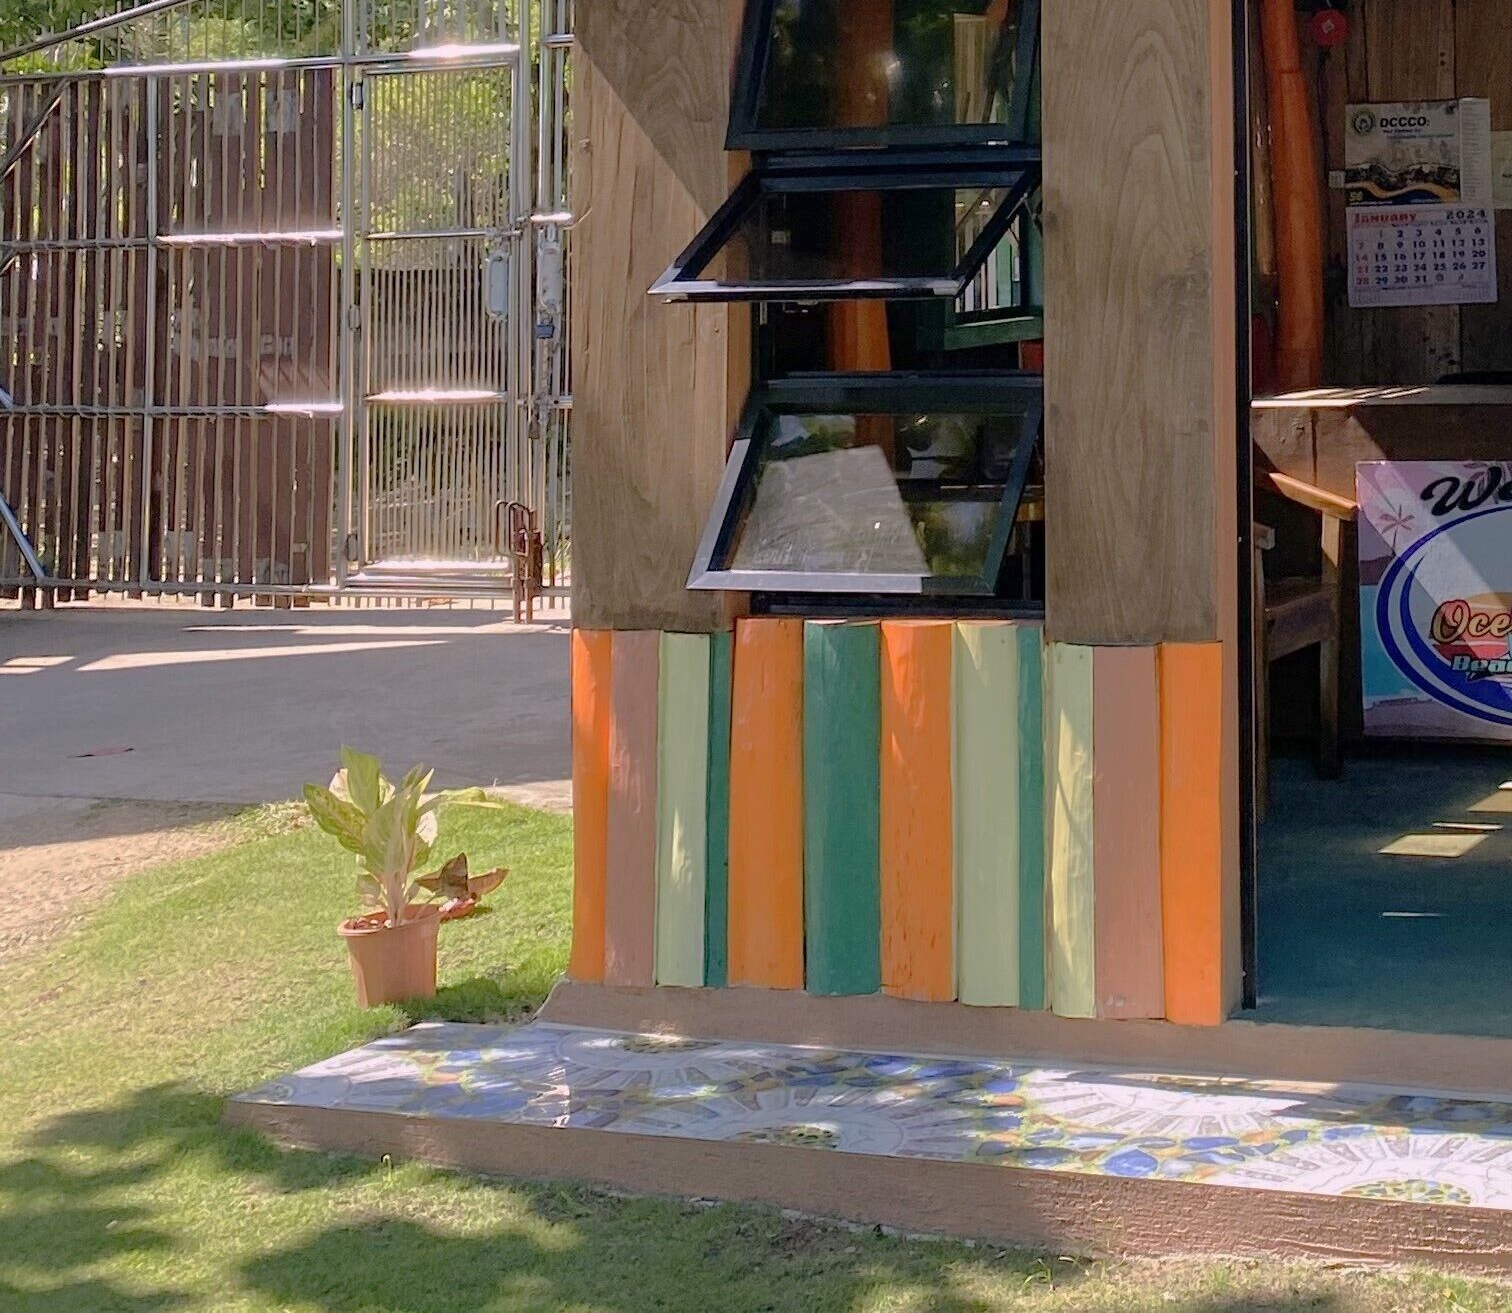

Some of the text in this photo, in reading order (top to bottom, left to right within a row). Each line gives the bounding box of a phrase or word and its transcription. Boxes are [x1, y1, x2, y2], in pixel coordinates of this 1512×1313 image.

[1446, 210, 1486, 220] 2024
[1433, 240, 1444, 248] 11
[1452, 239, 1465, 247] 12
[1472, 238, 1485, 246] 13
[1375, 253, 1387, 261] 15
[1394, 253, 1406, 261] 16
[1413, 252, 1425, 260] 17
[1472, 250, 1486, 258] 20
[1357, 266, 1369, 274] 21
[1414, 264, 1426, 272] 24
[1433, 263, 1446, 271] 25
[1472, 262, 1486, 270] 27
[1375, 277, 1388, 285] 29
[1415, 275, 1427, 283] 31
